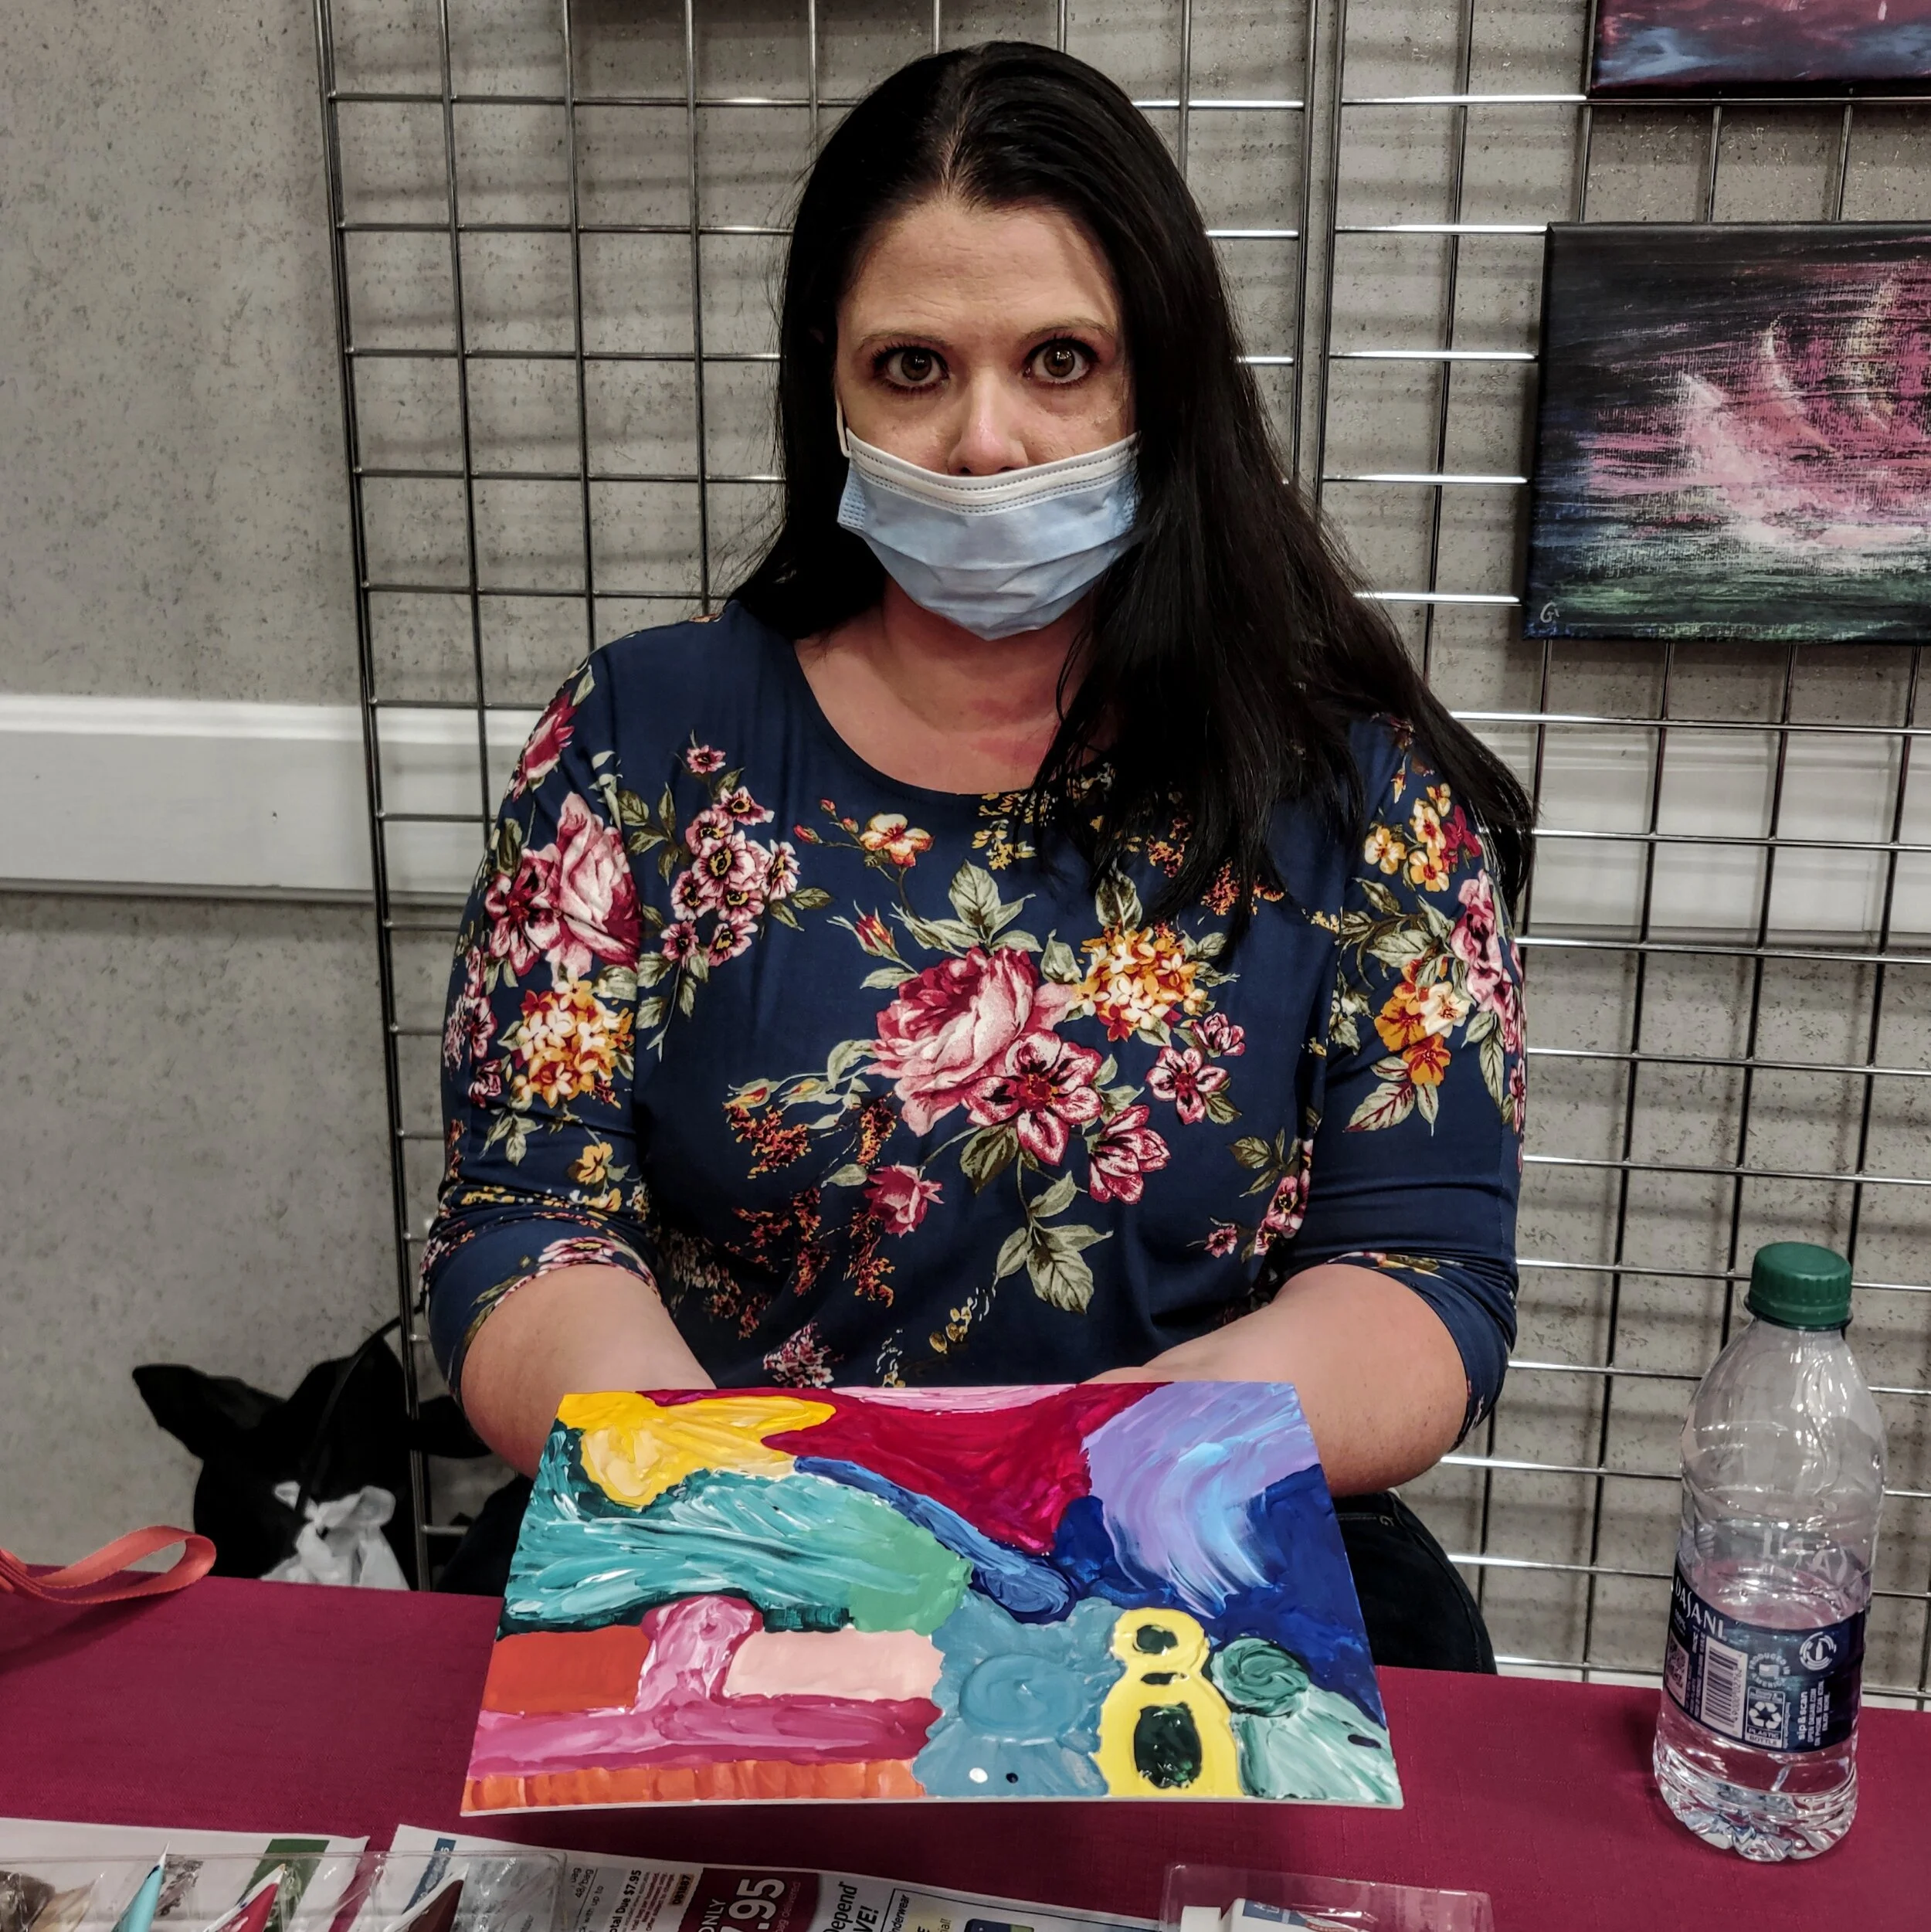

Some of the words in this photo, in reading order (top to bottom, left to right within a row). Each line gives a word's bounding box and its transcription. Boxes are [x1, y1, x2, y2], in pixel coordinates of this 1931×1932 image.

[1675, 1576, 1724, 1638] DASANI
[1748, 1727, 1779, 1740] PLASTIC
[1797, 1724, 1807, 1740] sip
[1749, 1735, 1777, 1746] BOTTLE
[616, 1898, 630, 1913] Due
[623, 1870, 641, 1895] $7.95
